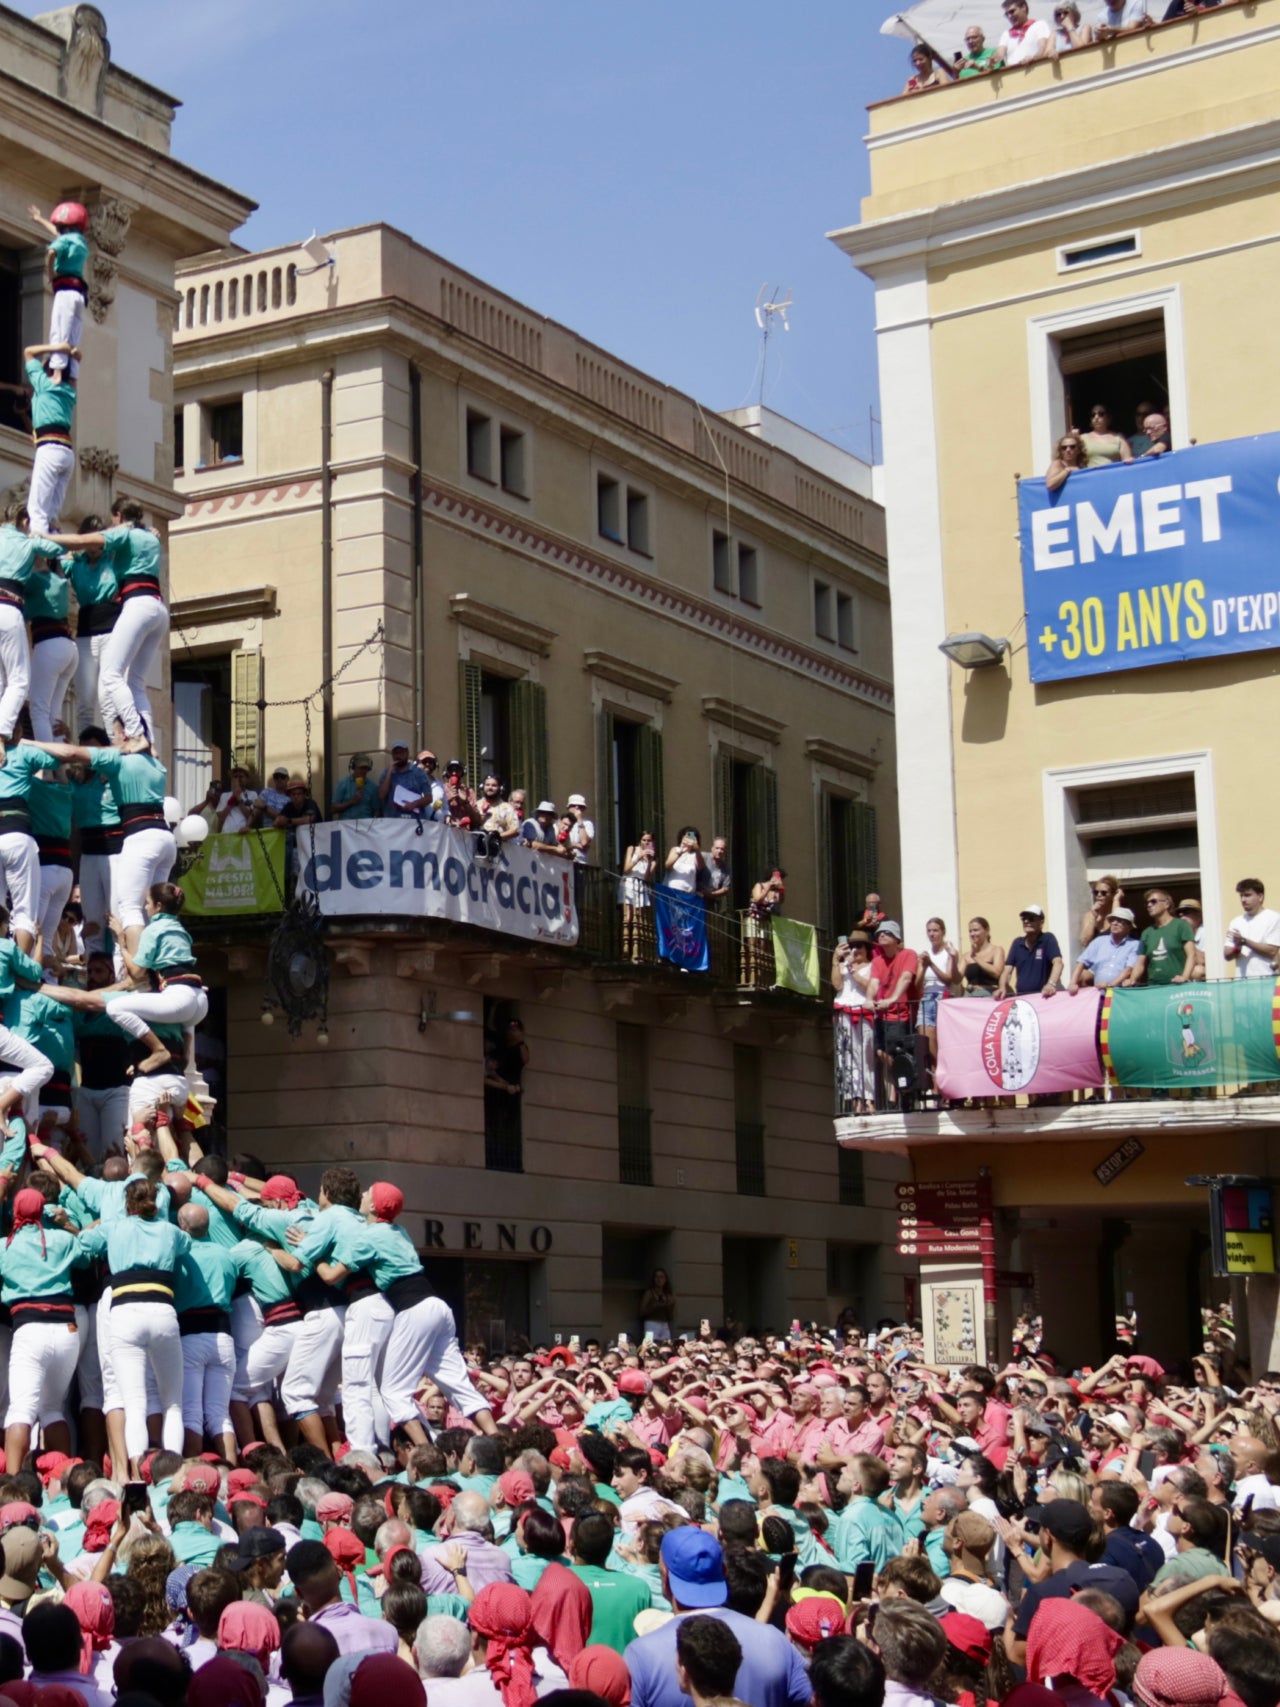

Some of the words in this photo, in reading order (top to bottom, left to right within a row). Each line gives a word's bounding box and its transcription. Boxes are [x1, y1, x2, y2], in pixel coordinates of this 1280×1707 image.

[1031, 475, 1233, 571] EMET
[1038, 597, 1106, 659] +30
[1117, 579, 1208, 651] ANYS
[1212, 591, 1280, 636] D'EXP
[984, 1010, 1003, 1040] VELLA
[984, 1041, 999, 1076] COLLA
[944, 1244, 979, 1252] Modernista
[1226, 1242, 1243, 1250] som
[1228, 1253, 1256, 1265] viatges
